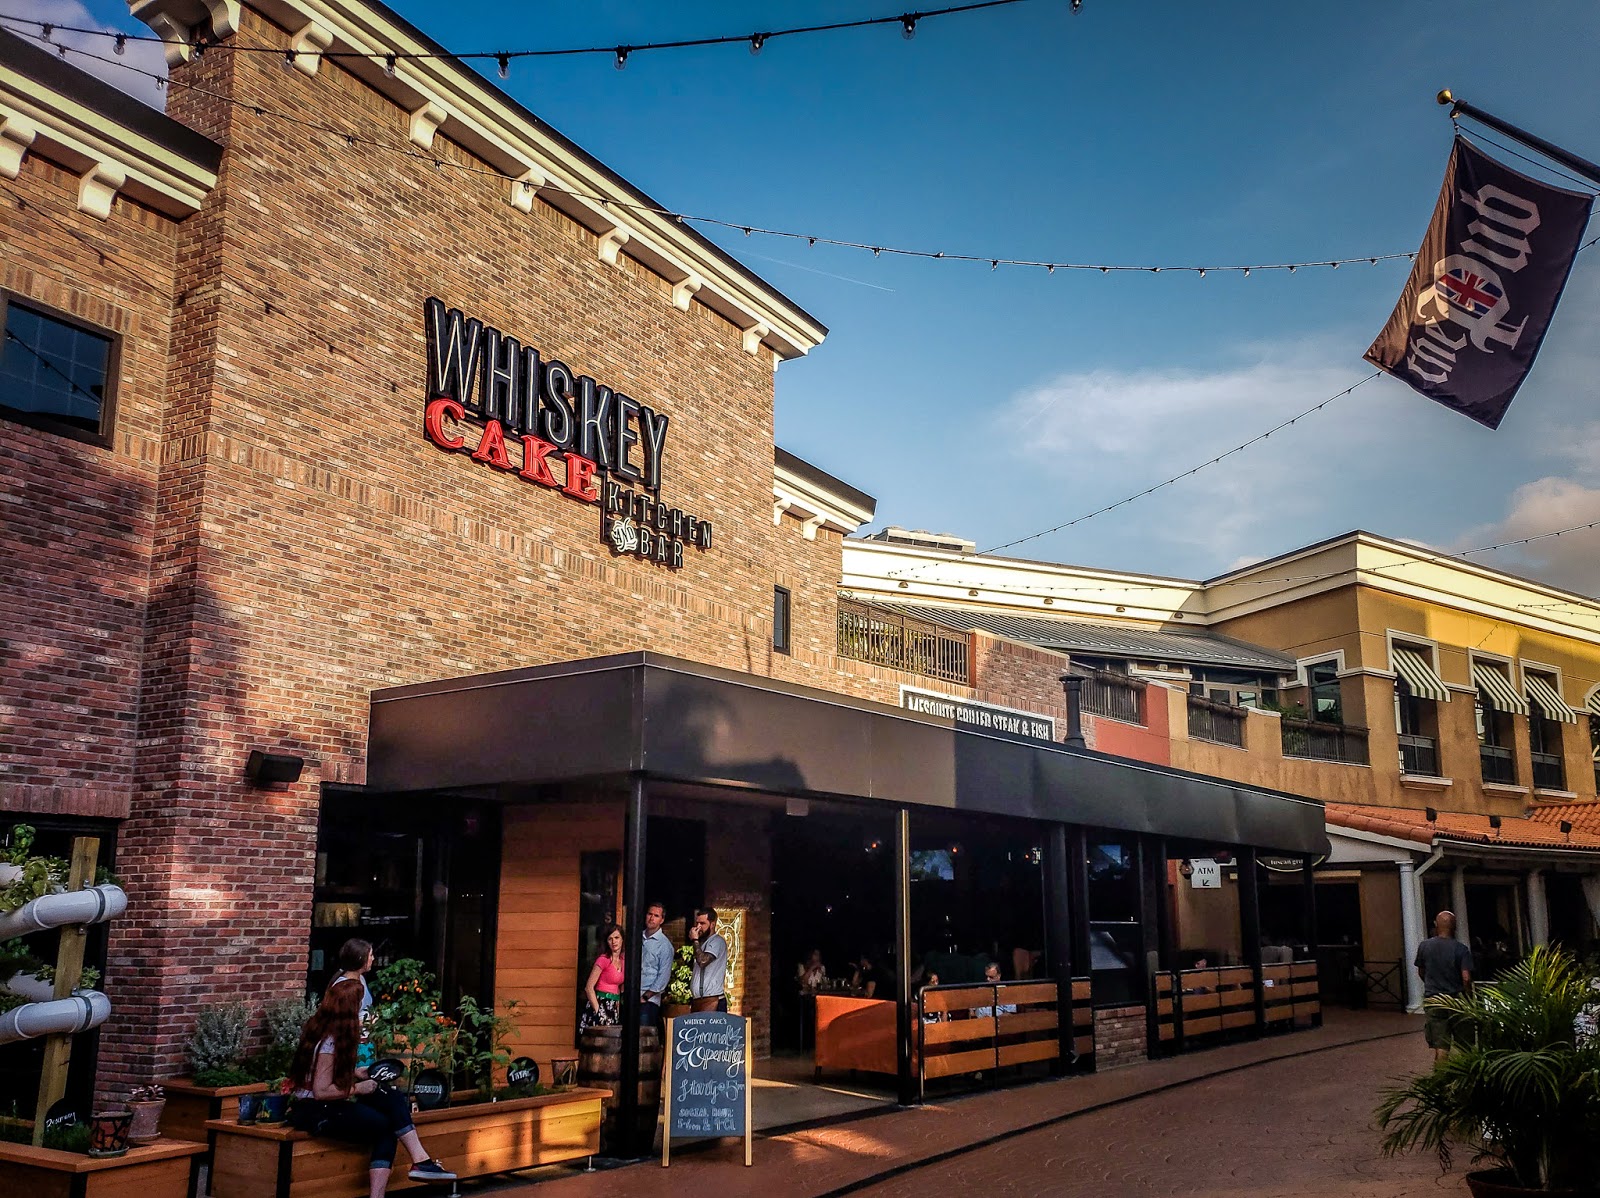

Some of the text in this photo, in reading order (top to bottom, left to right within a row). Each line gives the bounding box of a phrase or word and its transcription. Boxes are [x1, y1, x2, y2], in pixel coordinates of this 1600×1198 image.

[1417, 183, 1541, 354] Pub
[424, 296, 669, 491] WHISKEY
[425, 398, 598, 502] CAKE
[606, 481, 713, 549] KITCHEN
[639, 528, 684, 568] BAR
[908, 696, 1049, 740] MESQUITE GRILLED STEAK & FISH
[1197, 867, 1215, 875] ATM
[676, 1025, 732, 1055] Grand
[688, 1046, 745, 1078] Opening
